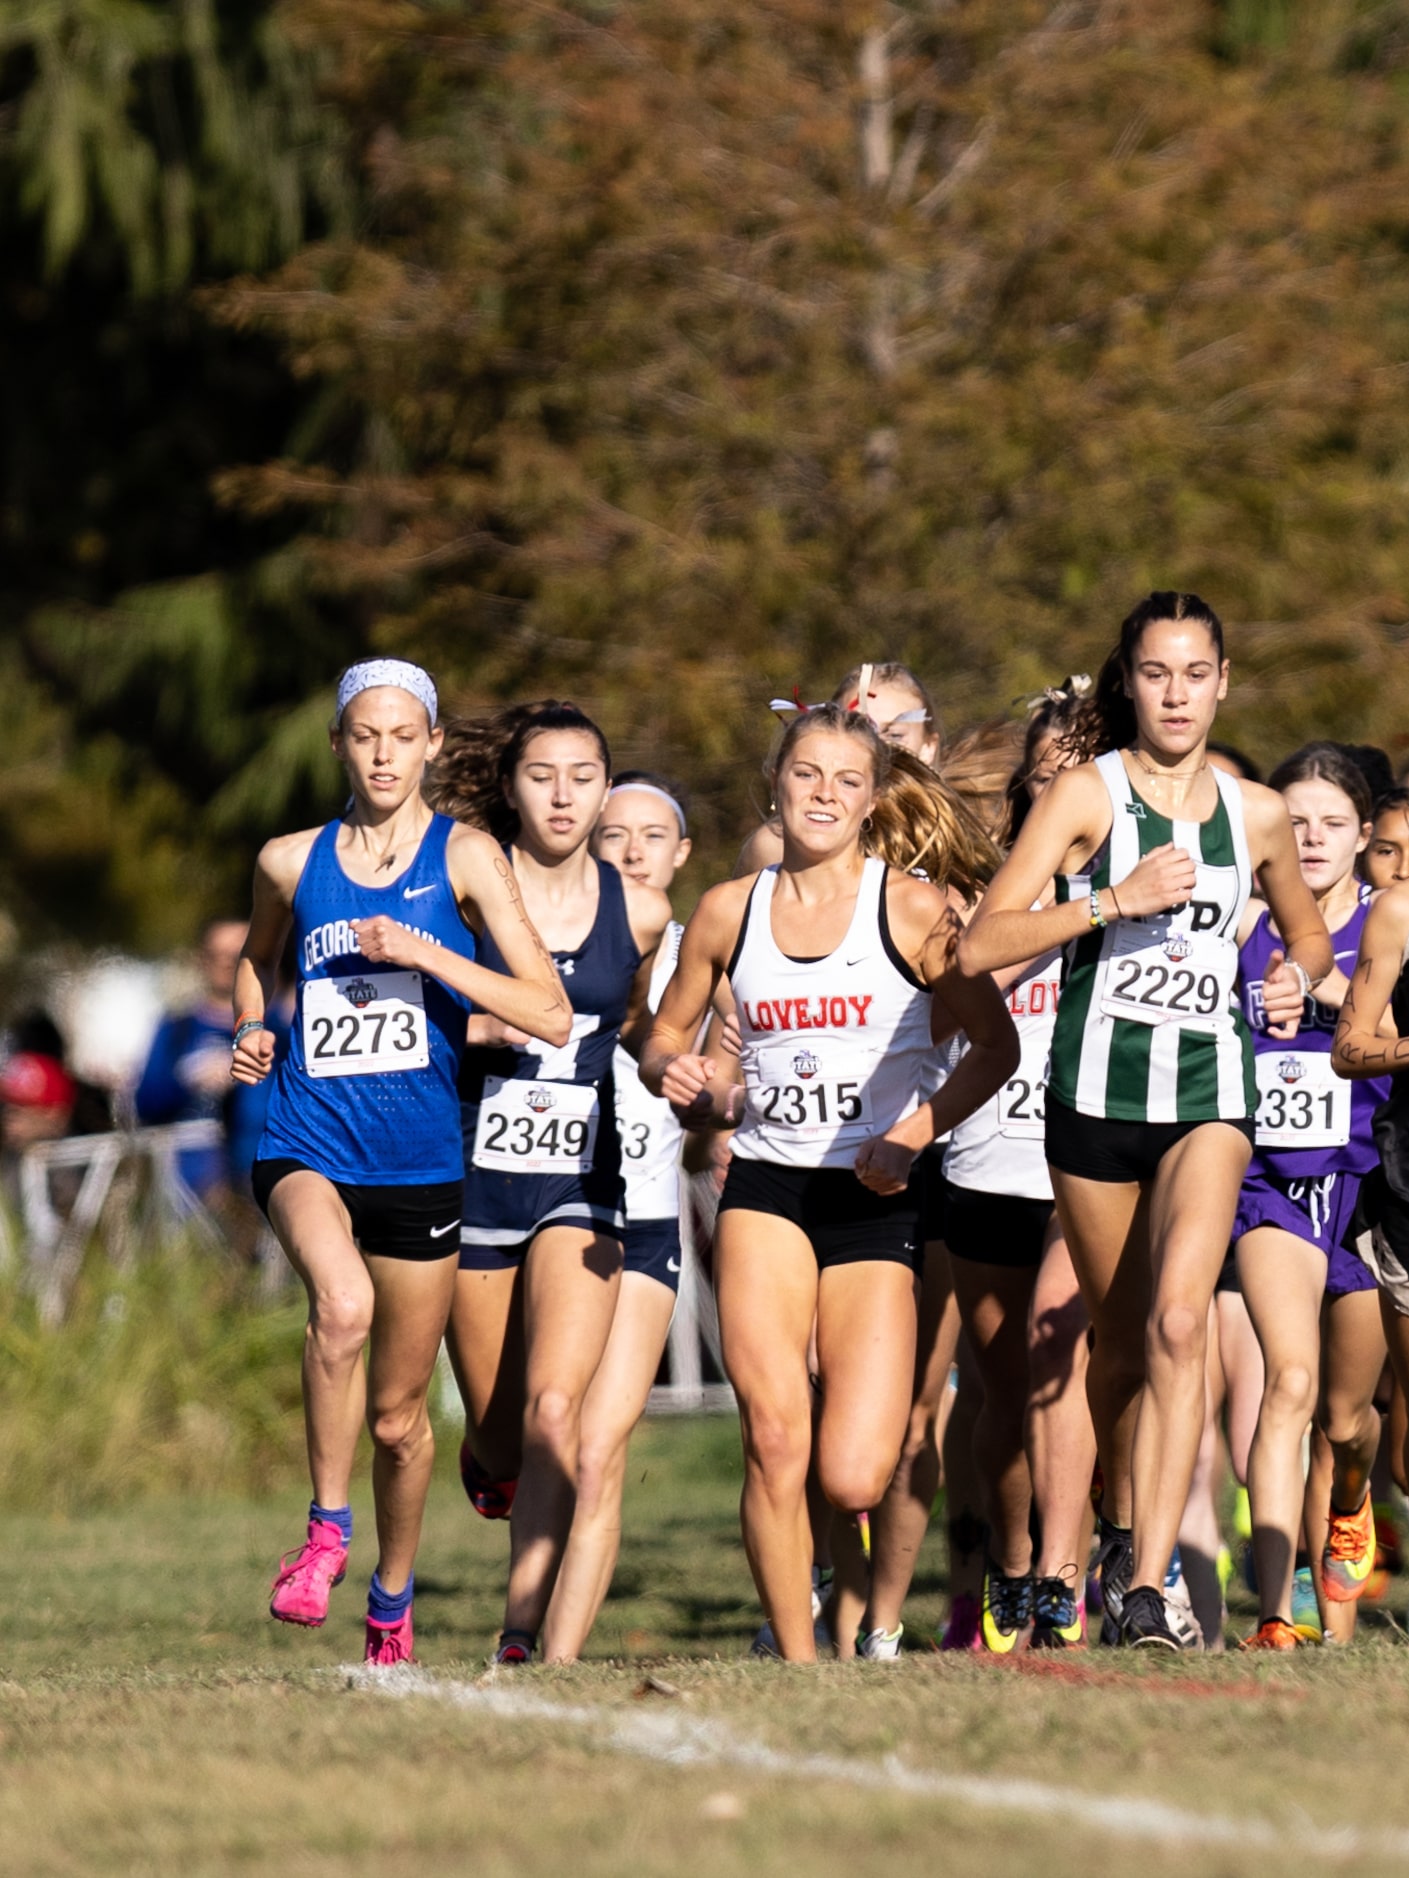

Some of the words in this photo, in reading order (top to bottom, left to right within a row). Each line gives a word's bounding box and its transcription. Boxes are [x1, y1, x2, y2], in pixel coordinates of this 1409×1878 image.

[304, 918, 442, 972] GEORG
[1112, 959, 1220, 1014] 2229
[312, 1010, 418, 1059] 2273
[743, 994, 873, 1032] LOVEJOY
[761, 1082, 862, 1125] 2315
[484, 1112, 588, 1156] 2349
